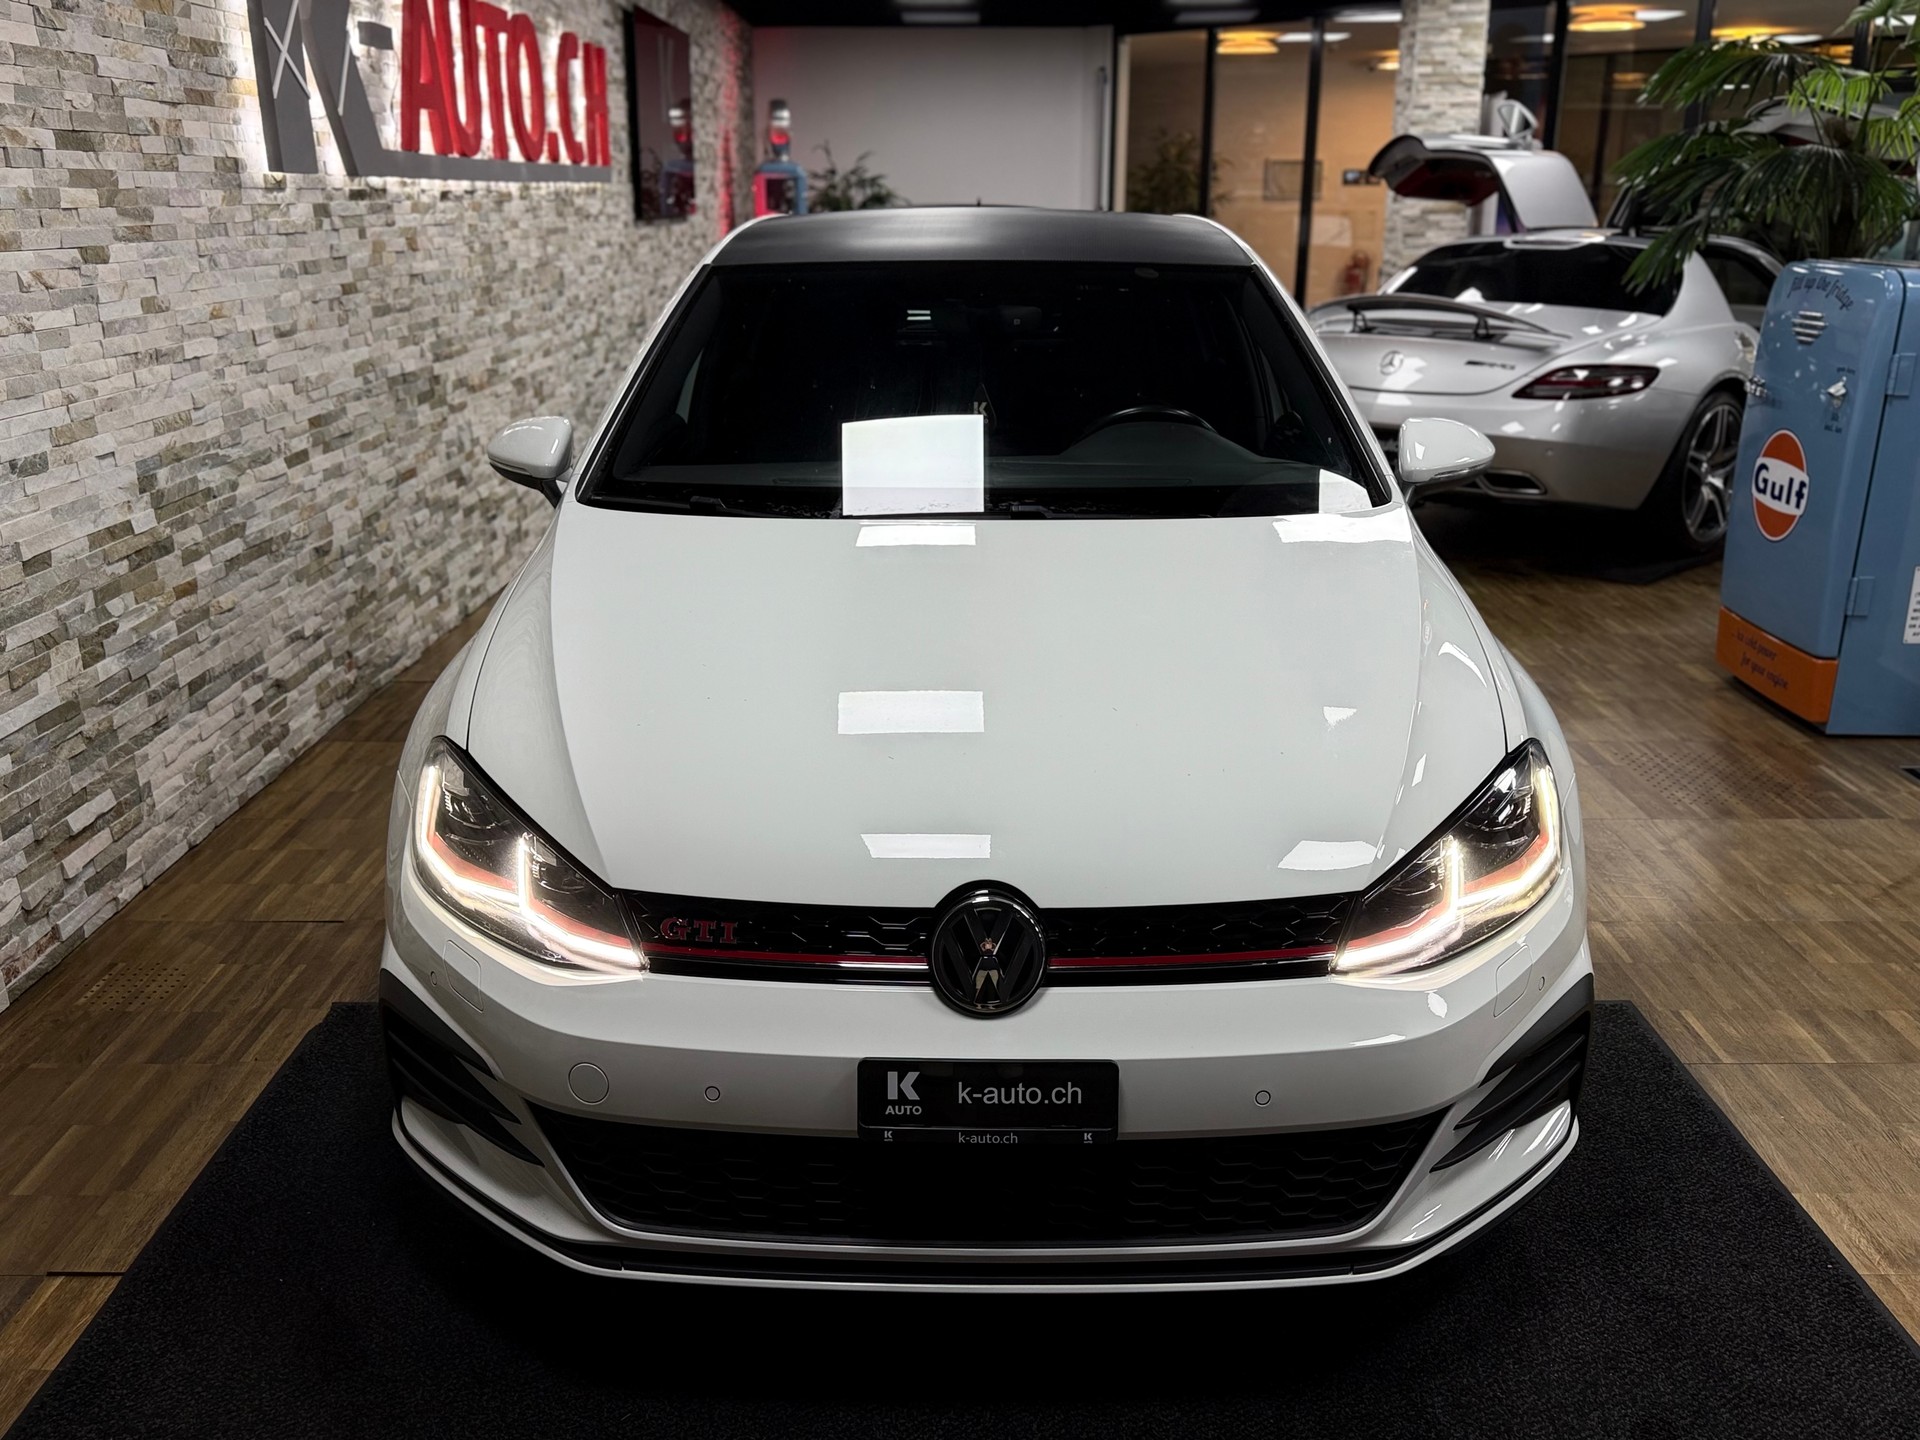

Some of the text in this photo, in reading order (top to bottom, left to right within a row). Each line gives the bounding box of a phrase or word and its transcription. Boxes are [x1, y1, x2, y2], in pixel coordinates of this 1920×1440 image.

[1754, 462, 1807, 510] Gulf
[659, 916, 739, 944] GTI
[887, 1071, 921, 1101] K
[957, 1081, 1083, 1105] k-auto.ch
[884, 1104, 923, 1116] AUTO
[957, 1131, 1019, 1145] k-auto.ch
